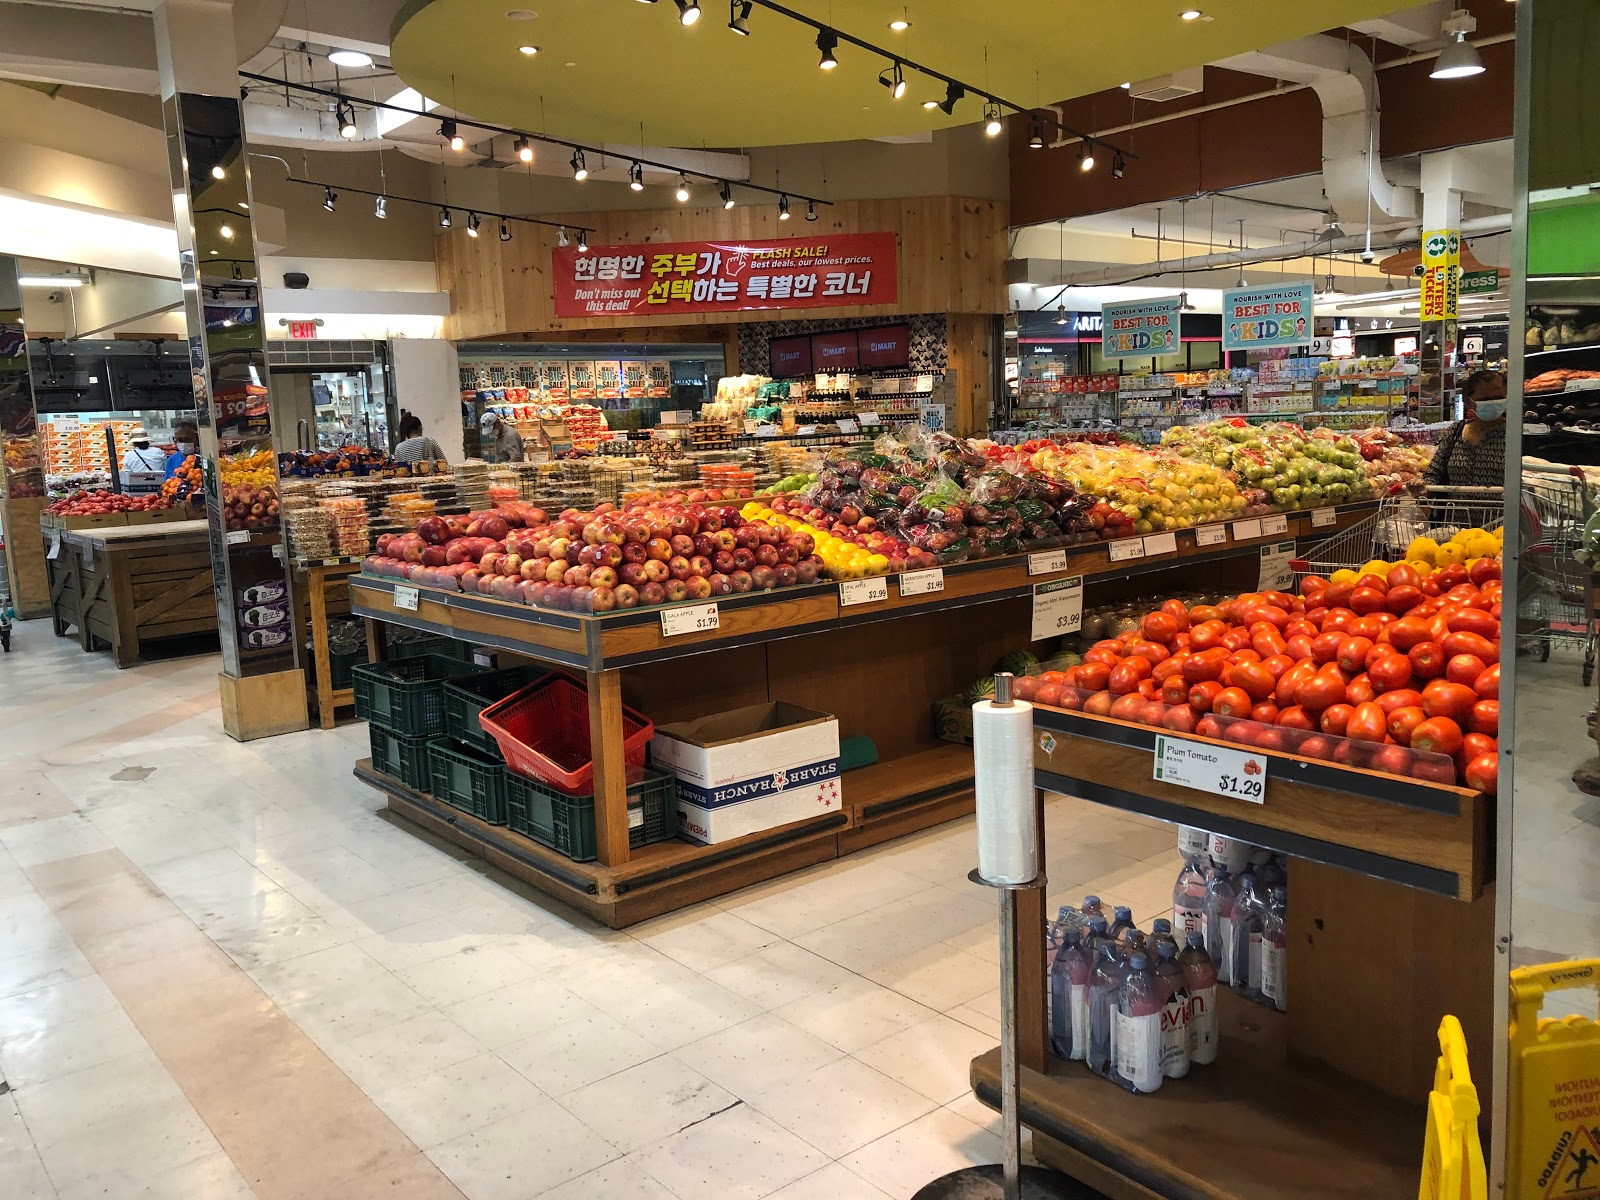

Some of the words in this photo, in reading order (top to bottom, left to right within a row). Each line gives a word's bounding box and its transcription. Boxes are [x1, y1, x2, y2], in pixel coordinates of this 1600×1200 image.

[752, 247, 792, 260] FLASH
[794, 246, 828, 258] SALE!
[574, 254, 645, 281] 현명한
[650, 251, 722, 278] 주부가
[751, 260, 770, 268] Best
[814, 256, 844, 266] lowest
[844, 256, 874, 264] prices.
[647, 278, 738, 304] 선택하는
[746, 273, 818, 299] 특별한
[822, 270, 871, 296] 코너
[1424, 266, 1436, 316] TICKETS
[574, 288, 600, 300] Don't
[601, 288, 623, 299] miss
[624, 288, 642, 298] out
[1234, 295, 1262, 303] NOURISH
[1284, 290, 1302, 298] LOVE
[586, 300, 604, 312] this
[605, 300, 630, 311] deal!
[1234, 303, 1272, 318] BEST
[1274, 301, 1302, 314] FOR
[1112, 316, 1143, 330] BEST
[1146, 314, 1170, 327] FOR
[292, 322, 314, 338] EXIT
[1240, 318, 1296, 340] KIDS
[878, 342, 896, 350] MART
[1118, 330, 1164, 351] KIDS
[1313, 340, 1321, 352] 9
[1467, 340, 1474, 350] 6
[785, 352, 800, 360] MART
[828, 347, 846, 355] MART
[460, 373, 477, 382] BIG
[491, 372, 506, 381] BIG
[520, 372, 535, 381] BIG
[548, 372, 562, 381] BIG
[576, 372, 590, 380] BIG
[602, 372, 615, 380] BIG
[628, 372, 641, 380] BIG
[652, 372, 666, 380] BIG
[927, 416, 940, 427] BIG
[1047, 580, 1073, 591] ORGANIC
[868, 589, 886, 600] $2.99
[696, 617, 718, 628] $1.79
[1056, 613, 1080, 628] $3.99
[1167, 745, 1186, 757] Plum
[1187, 749, 1218, 763] Tomato
[790, 762, 837, 783] STARR
[714, 779, 771, 802] RANCH
[1219, 774, 1262, 797] $1.29
[683, 790, 706, 804] STARR
